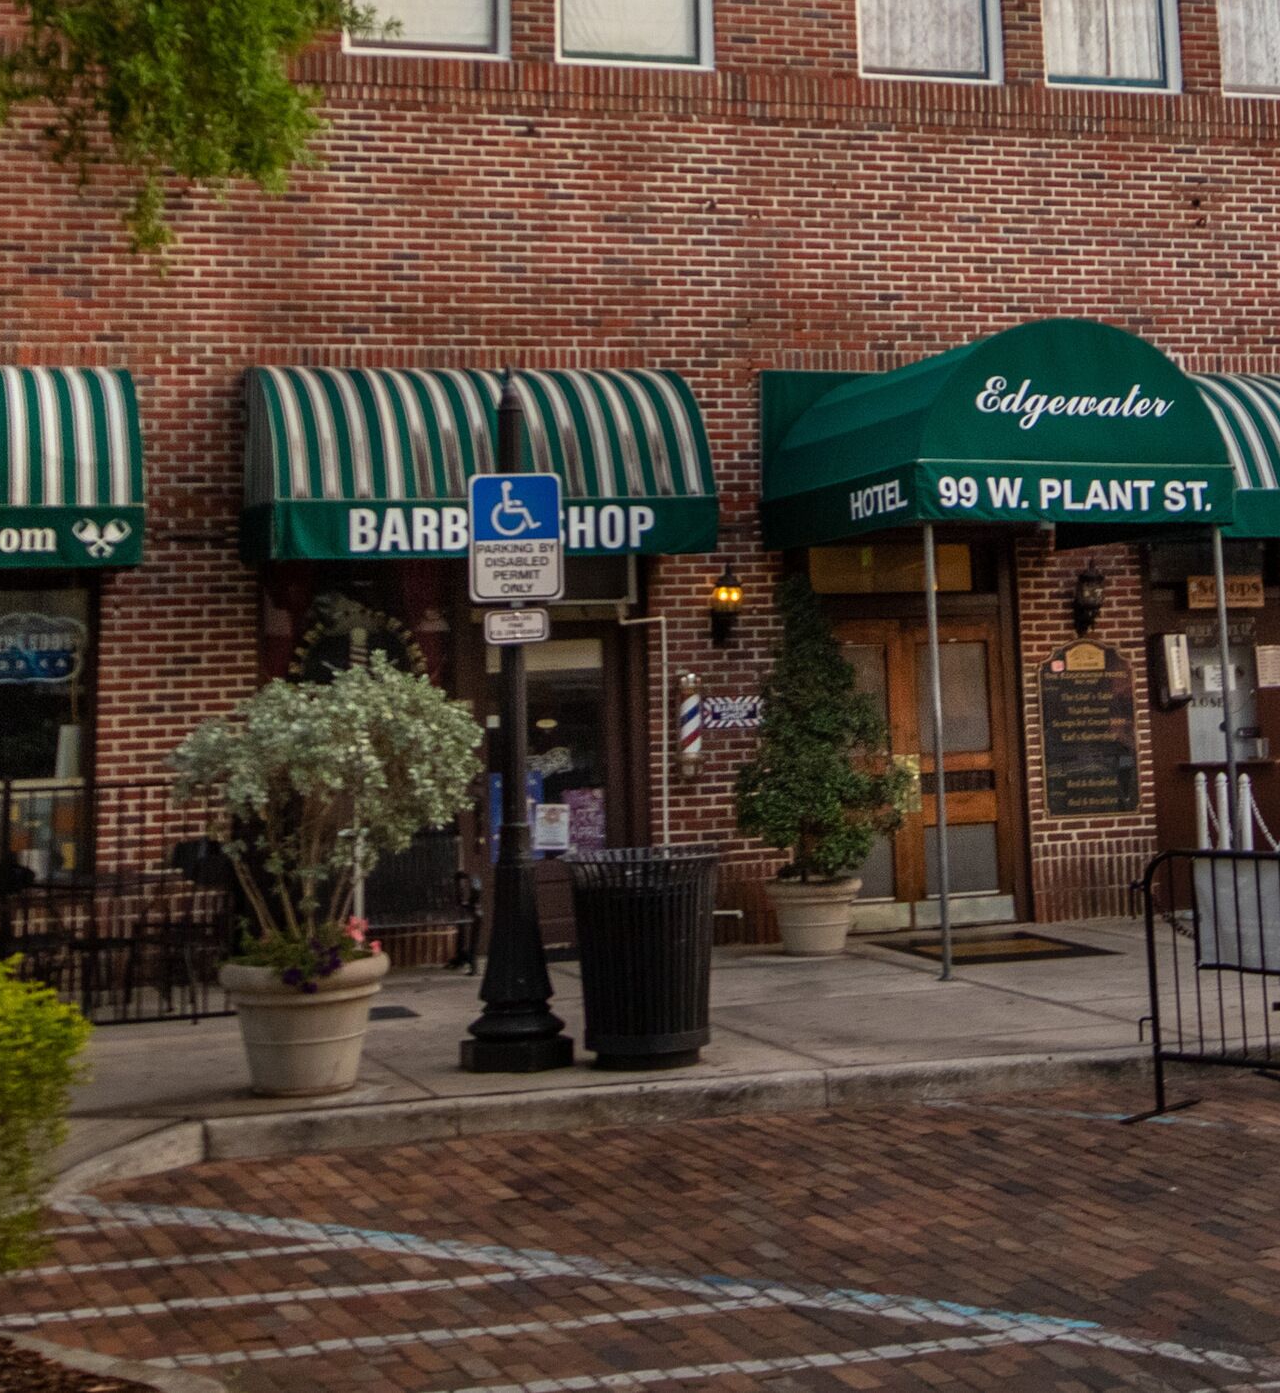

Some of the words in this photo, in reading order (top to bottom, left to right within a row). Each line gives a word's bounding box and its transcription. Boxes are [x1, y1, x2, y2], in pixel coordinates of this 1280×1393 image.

[975, 375, 1175, 430] Edgewater
[850, 479, 908, 520] HOTEL
[937, 476, 978, 508] 99
[986, 477, 1030, 509] W.
[1039, 478, 1156, 511] PLANT
[1163, 480, 1212, 512] ST.
[349, 507, 469, 552] BARB
[476, 543, 534, 554] PARKING
[538, 542, 555, 553] BY
[484, 556, 549, 567] DISABLED
[493, 569, 541, 580] PERMIT
[500, 583, 534, 594] ONLY
